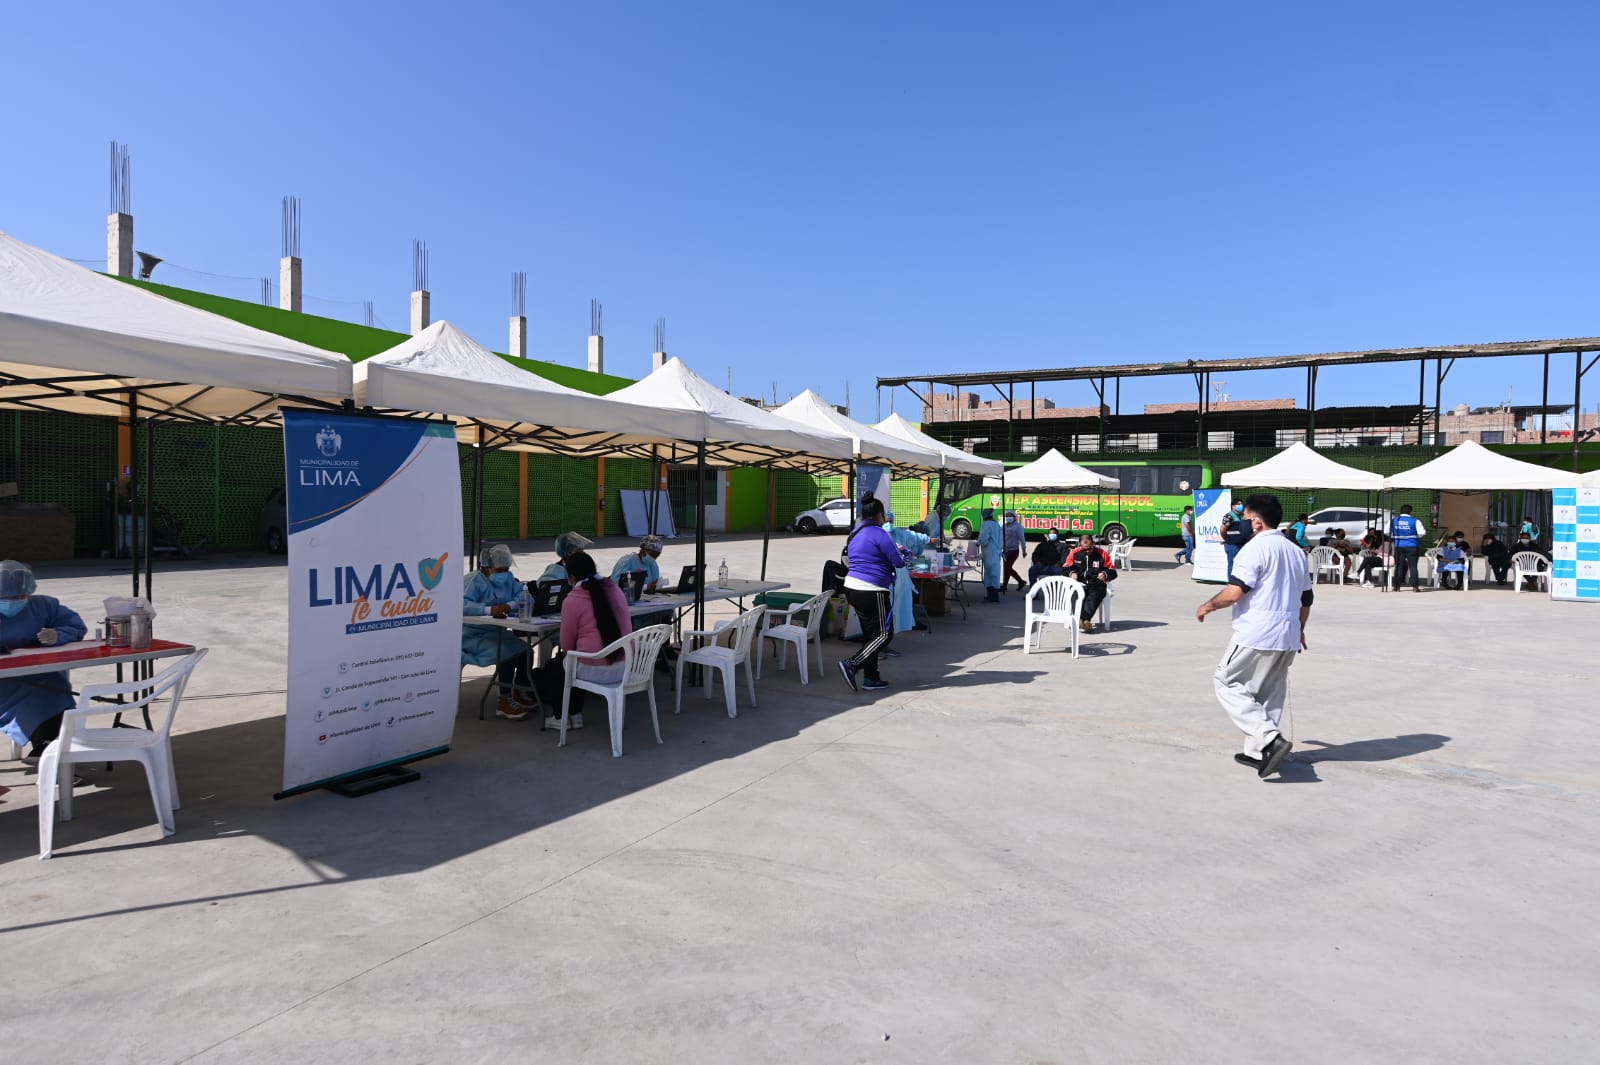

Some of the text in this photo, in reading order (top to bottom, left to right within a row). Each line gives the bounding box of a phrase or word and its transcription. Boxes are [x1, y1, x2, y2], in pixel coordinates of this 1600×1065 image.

[300, 469, 361, 487] LIMA
[1031, 495, 1099, 506] ASCENSION
[1102, 495, 1154, 507] SCHOOL
[1198, 525, 1219, 536] LIMA
[309, 562, 416, 607] LIMA
[351, 589, 434, 625] te cuida
[358, 615, 435, 633] MUNICIPALIDAD DE LIMA
